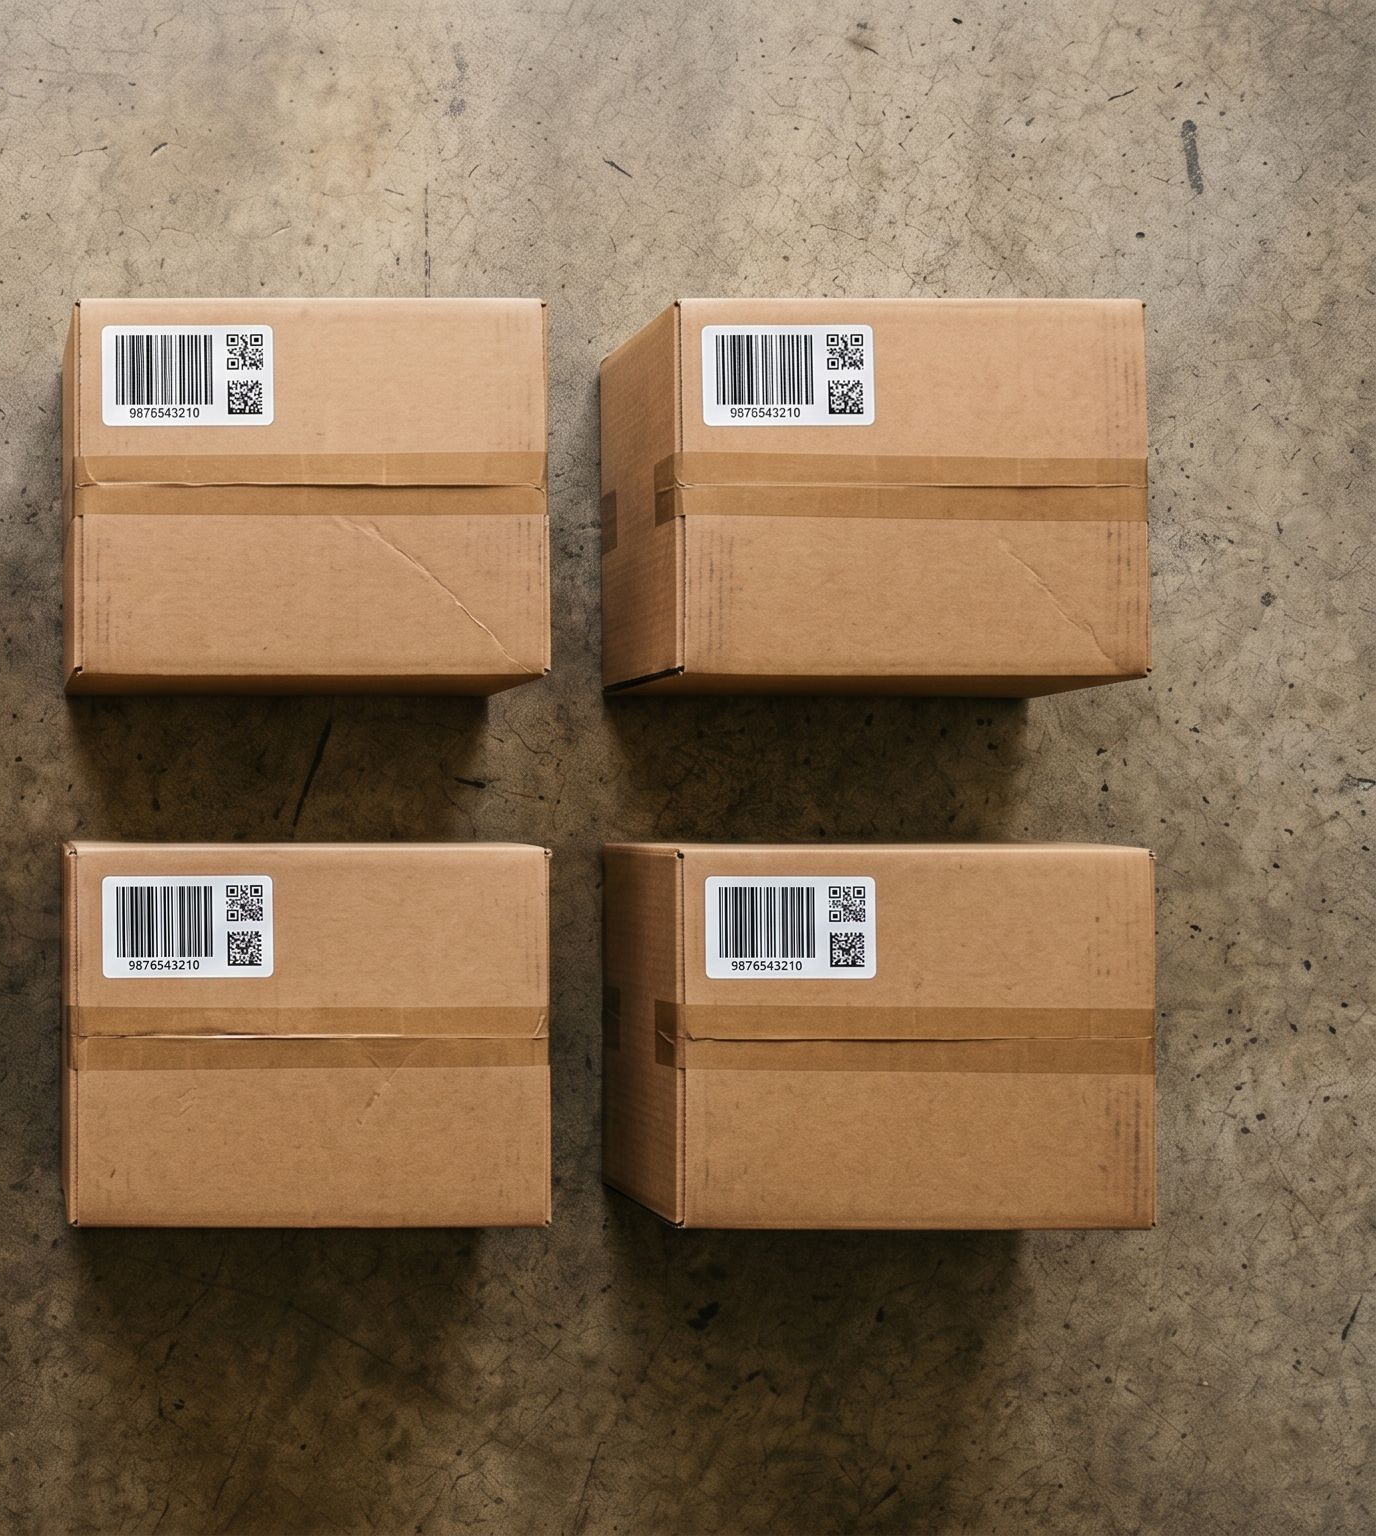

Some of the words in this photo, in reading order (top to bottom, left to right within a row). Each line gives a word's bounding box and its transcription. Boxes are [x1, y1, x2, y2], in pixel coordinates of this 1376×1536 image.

[129, 407, 200, 419] 9876543210
[730, 407, 801, 419] 9876543210
[128, 959, 200, 971] 9876543210
[731, 960, 803, 971] 9876543210
